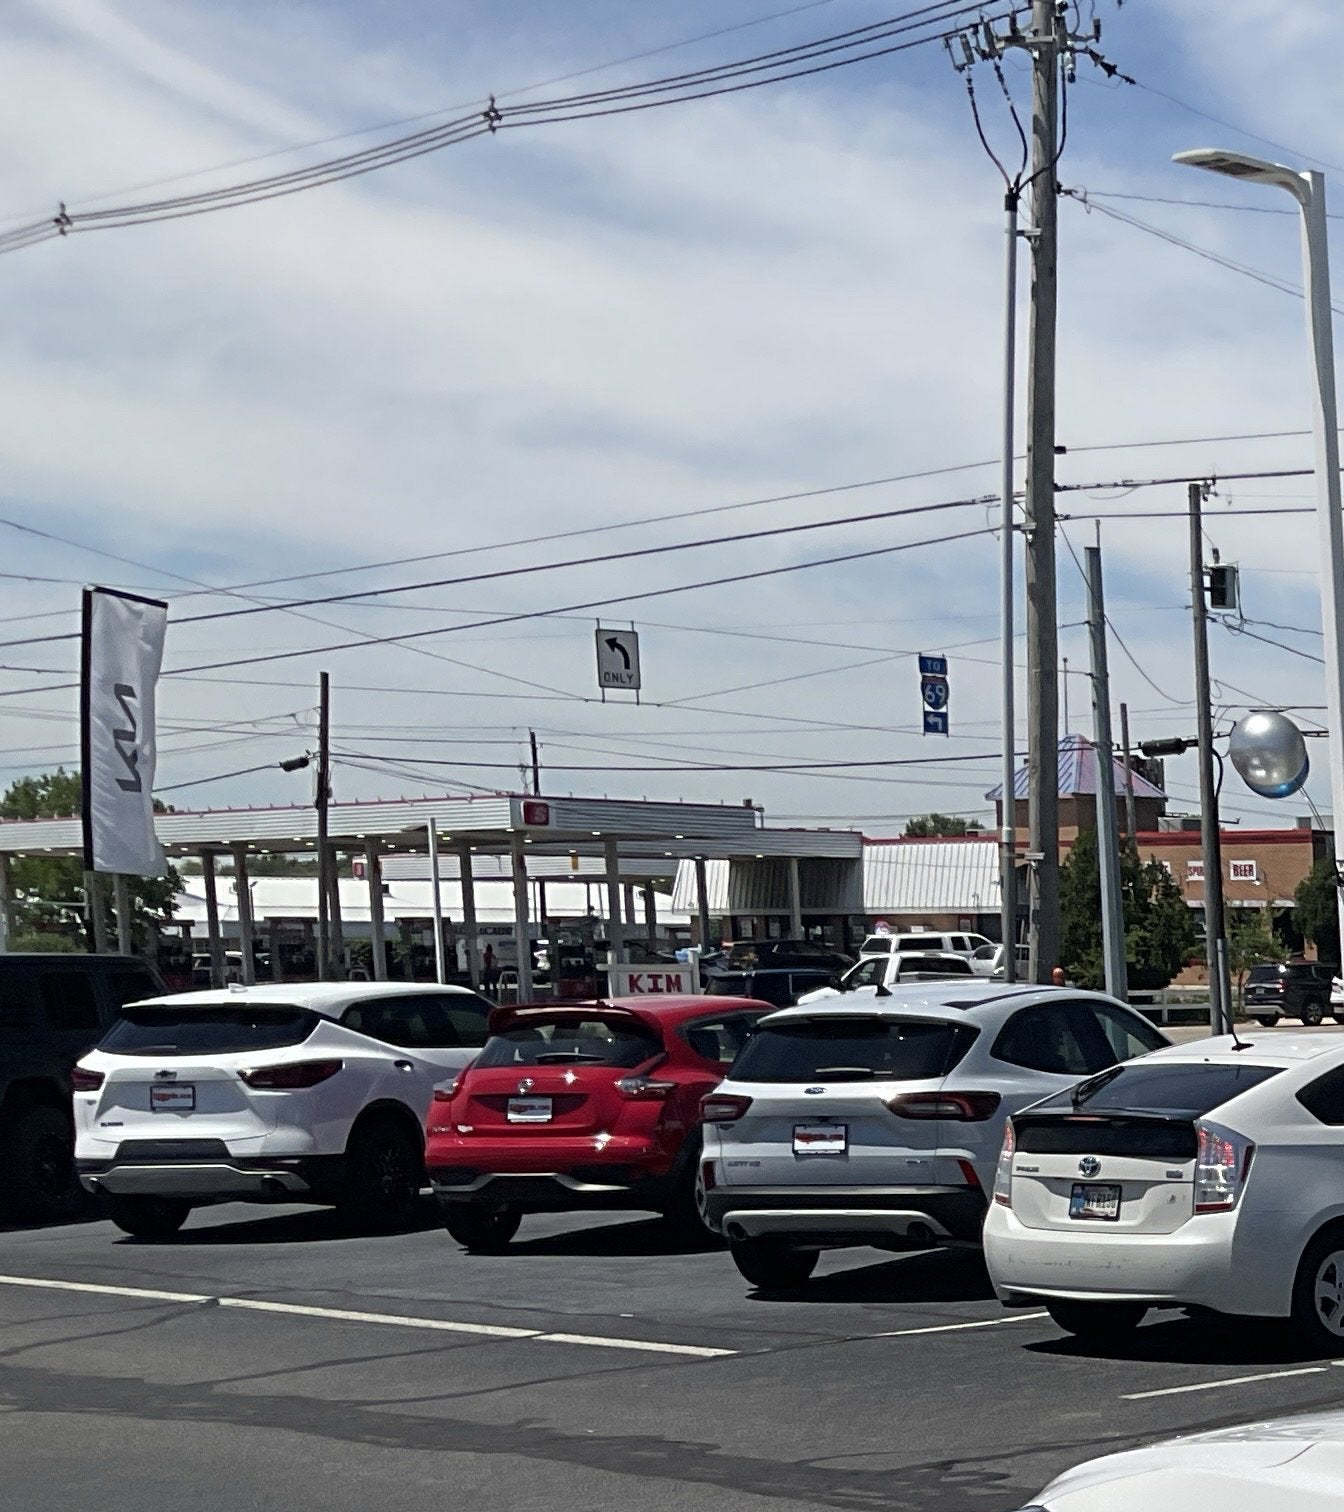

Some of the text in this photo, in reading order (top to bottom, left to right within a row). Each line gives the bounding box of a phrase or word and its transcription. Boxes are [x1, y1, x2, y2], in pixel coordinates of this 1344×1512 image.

[926, 660, 941, 672] TO
[603, 672, 634, 684] ONLY
[925, 685, 946, 703] 69
[1232, 864, 1254, 877] BEER
[628, 973, 683, 994] KIM
